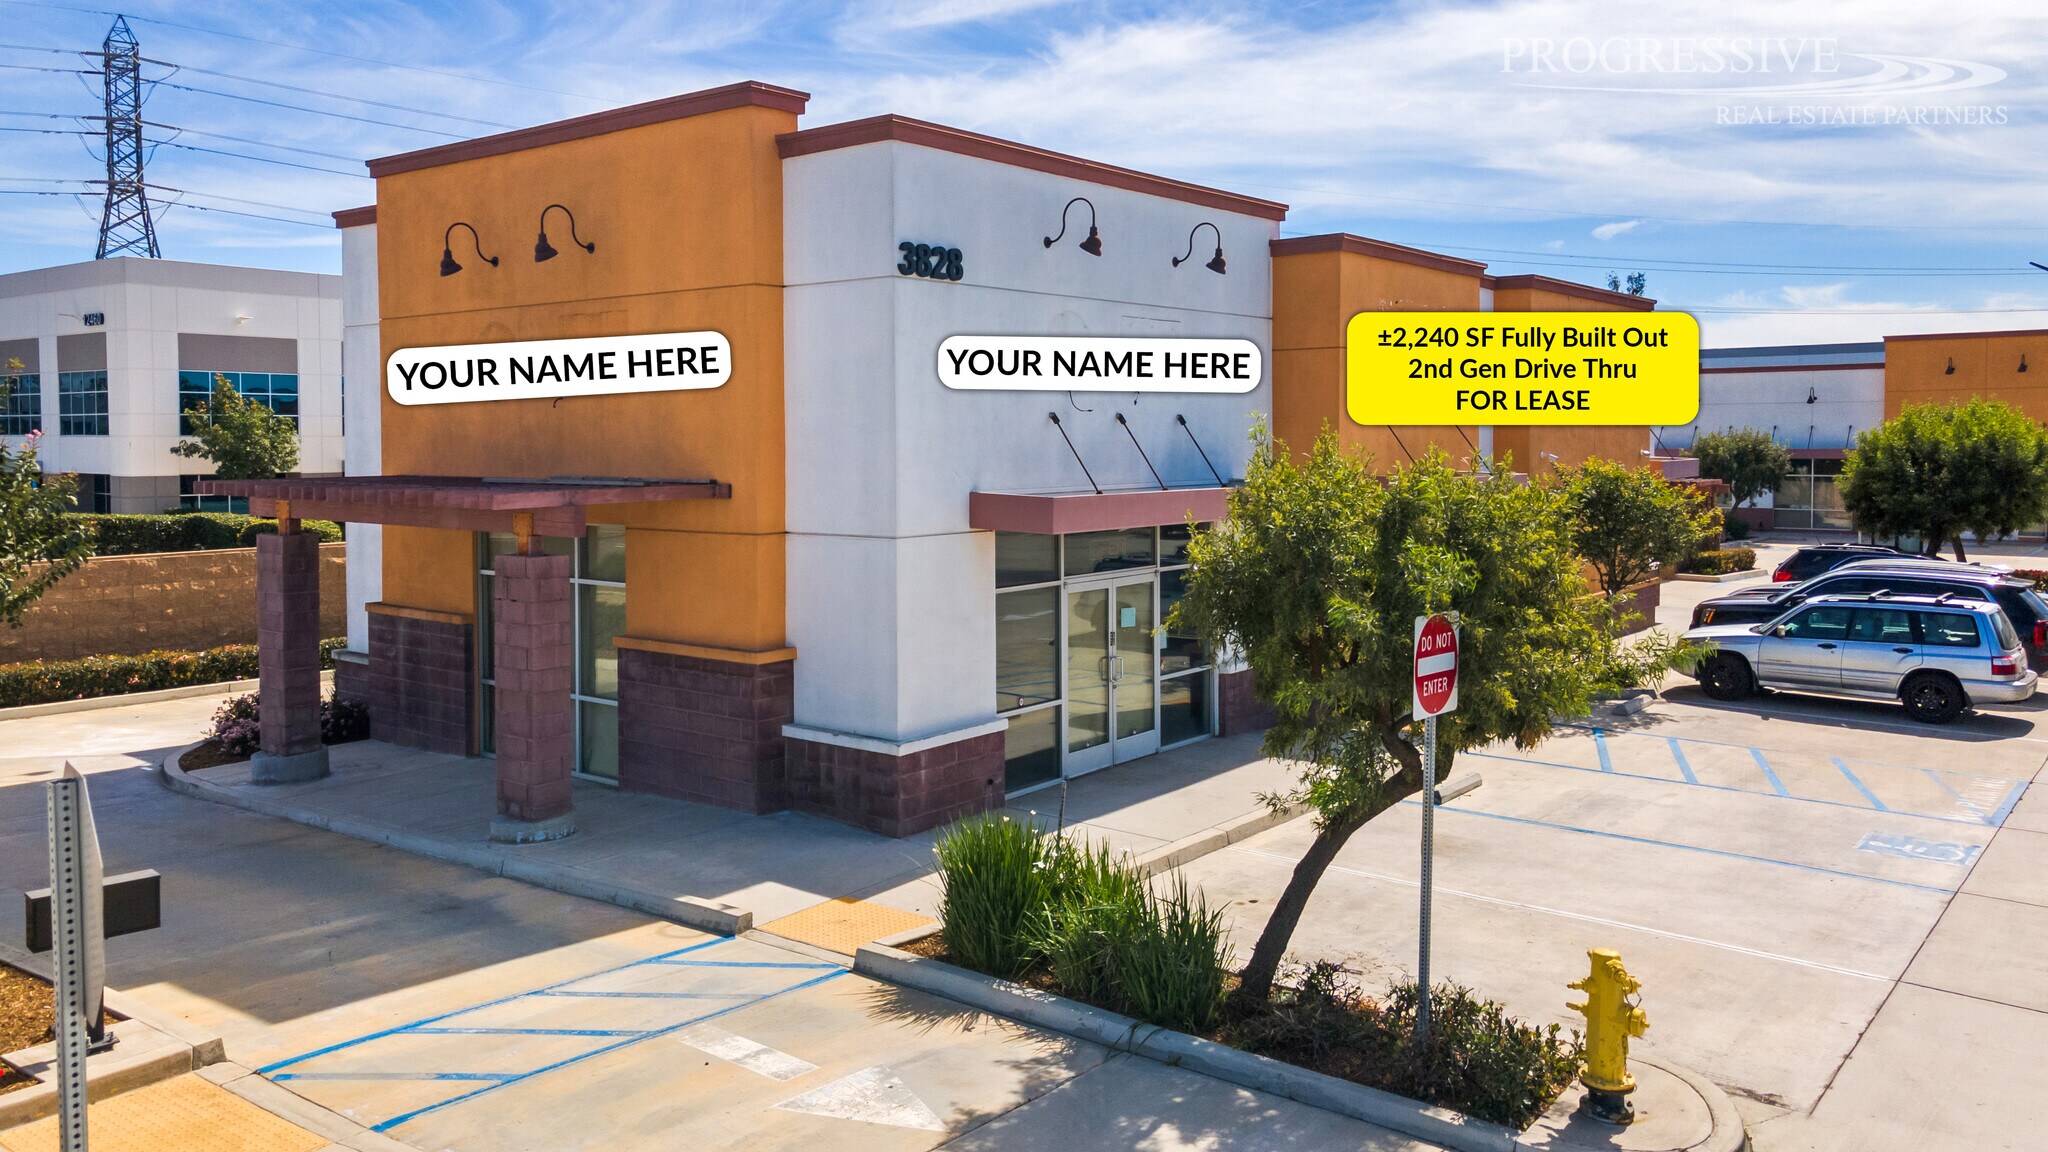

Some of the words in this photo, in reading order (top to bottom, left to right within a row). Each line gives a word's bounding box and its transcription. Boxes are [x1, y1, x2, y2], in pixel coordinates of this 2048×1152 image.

[897, 241, 964, 281] 3828
[1421, 635, 1433, 652] DO
[1436, 632, 1452, 649] NOT
[1423, 677, 1448, 697] ENTER
